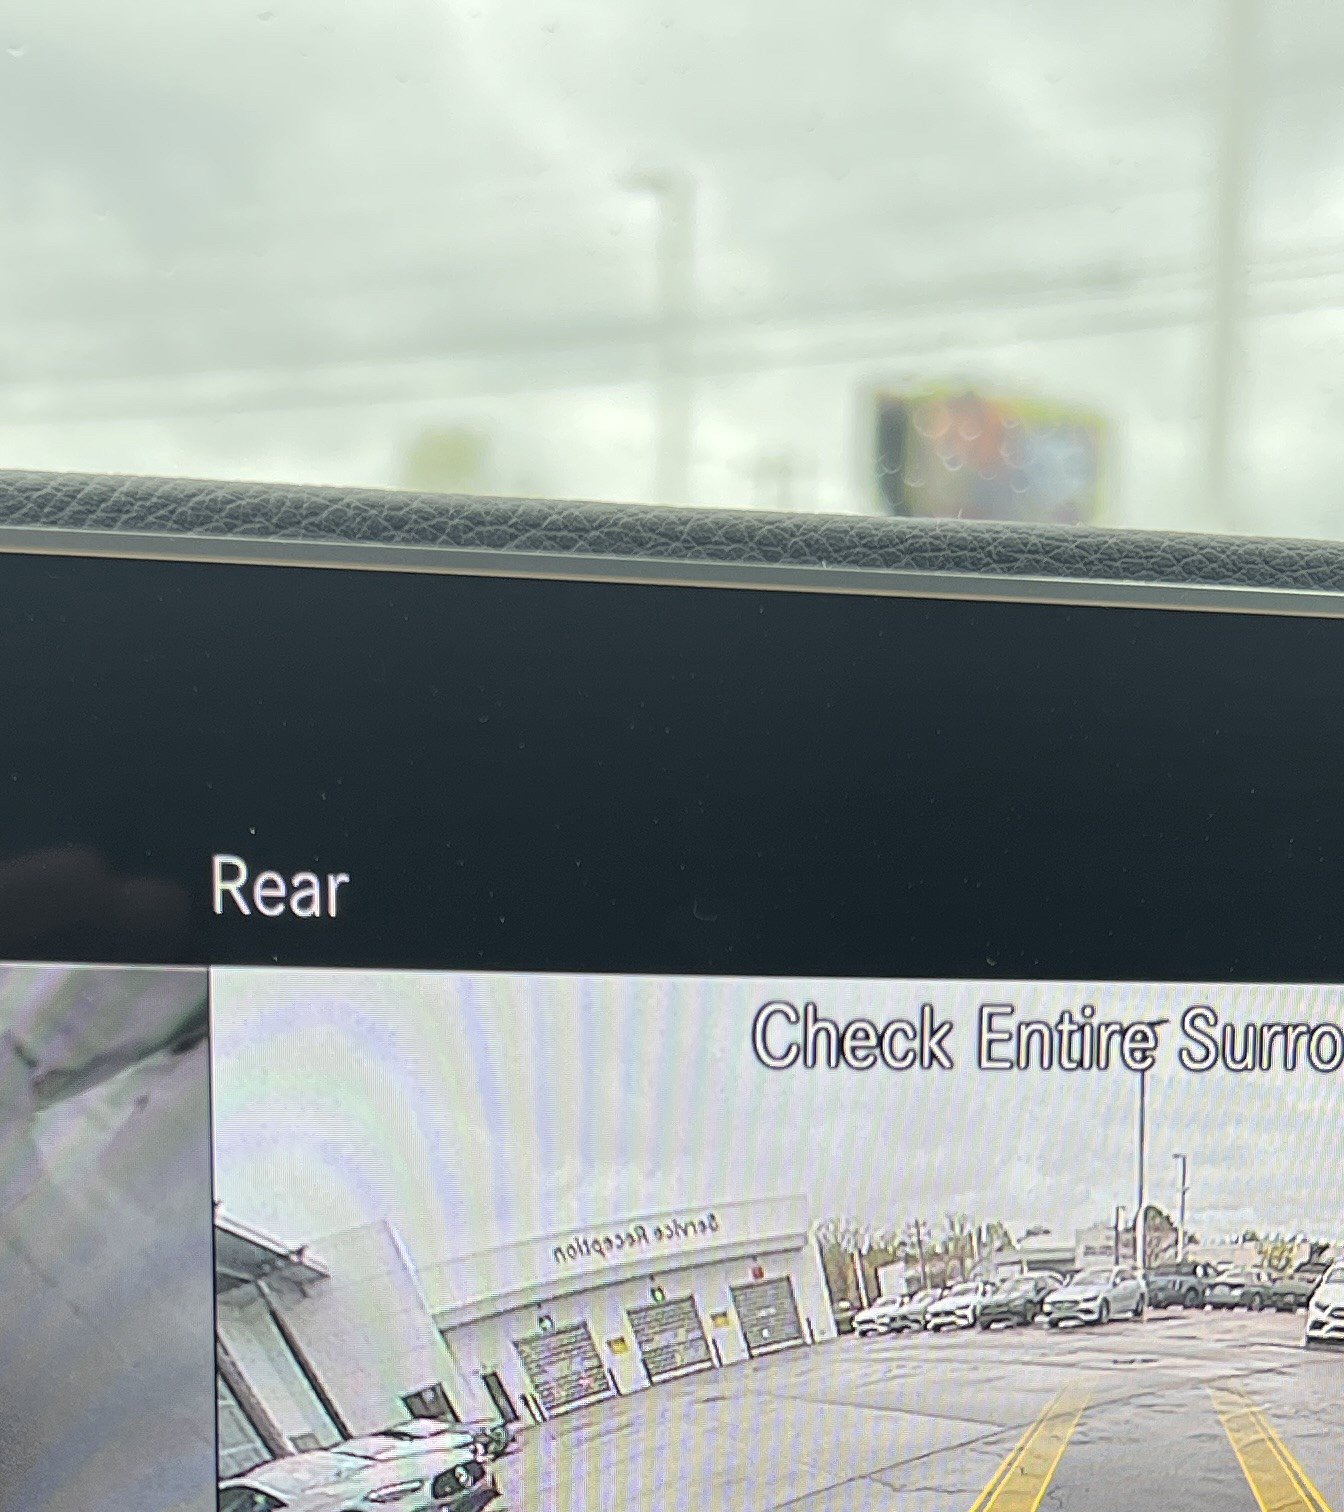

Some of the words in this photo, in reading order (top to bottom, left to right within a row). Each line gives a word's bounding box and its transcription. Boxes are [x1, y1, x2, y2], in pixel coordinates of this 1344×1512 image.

[212, 855, 350, 917] Rear
[752, 1002, 954, 1071] Check
[977, 1004, 1158, 1072] Entire
